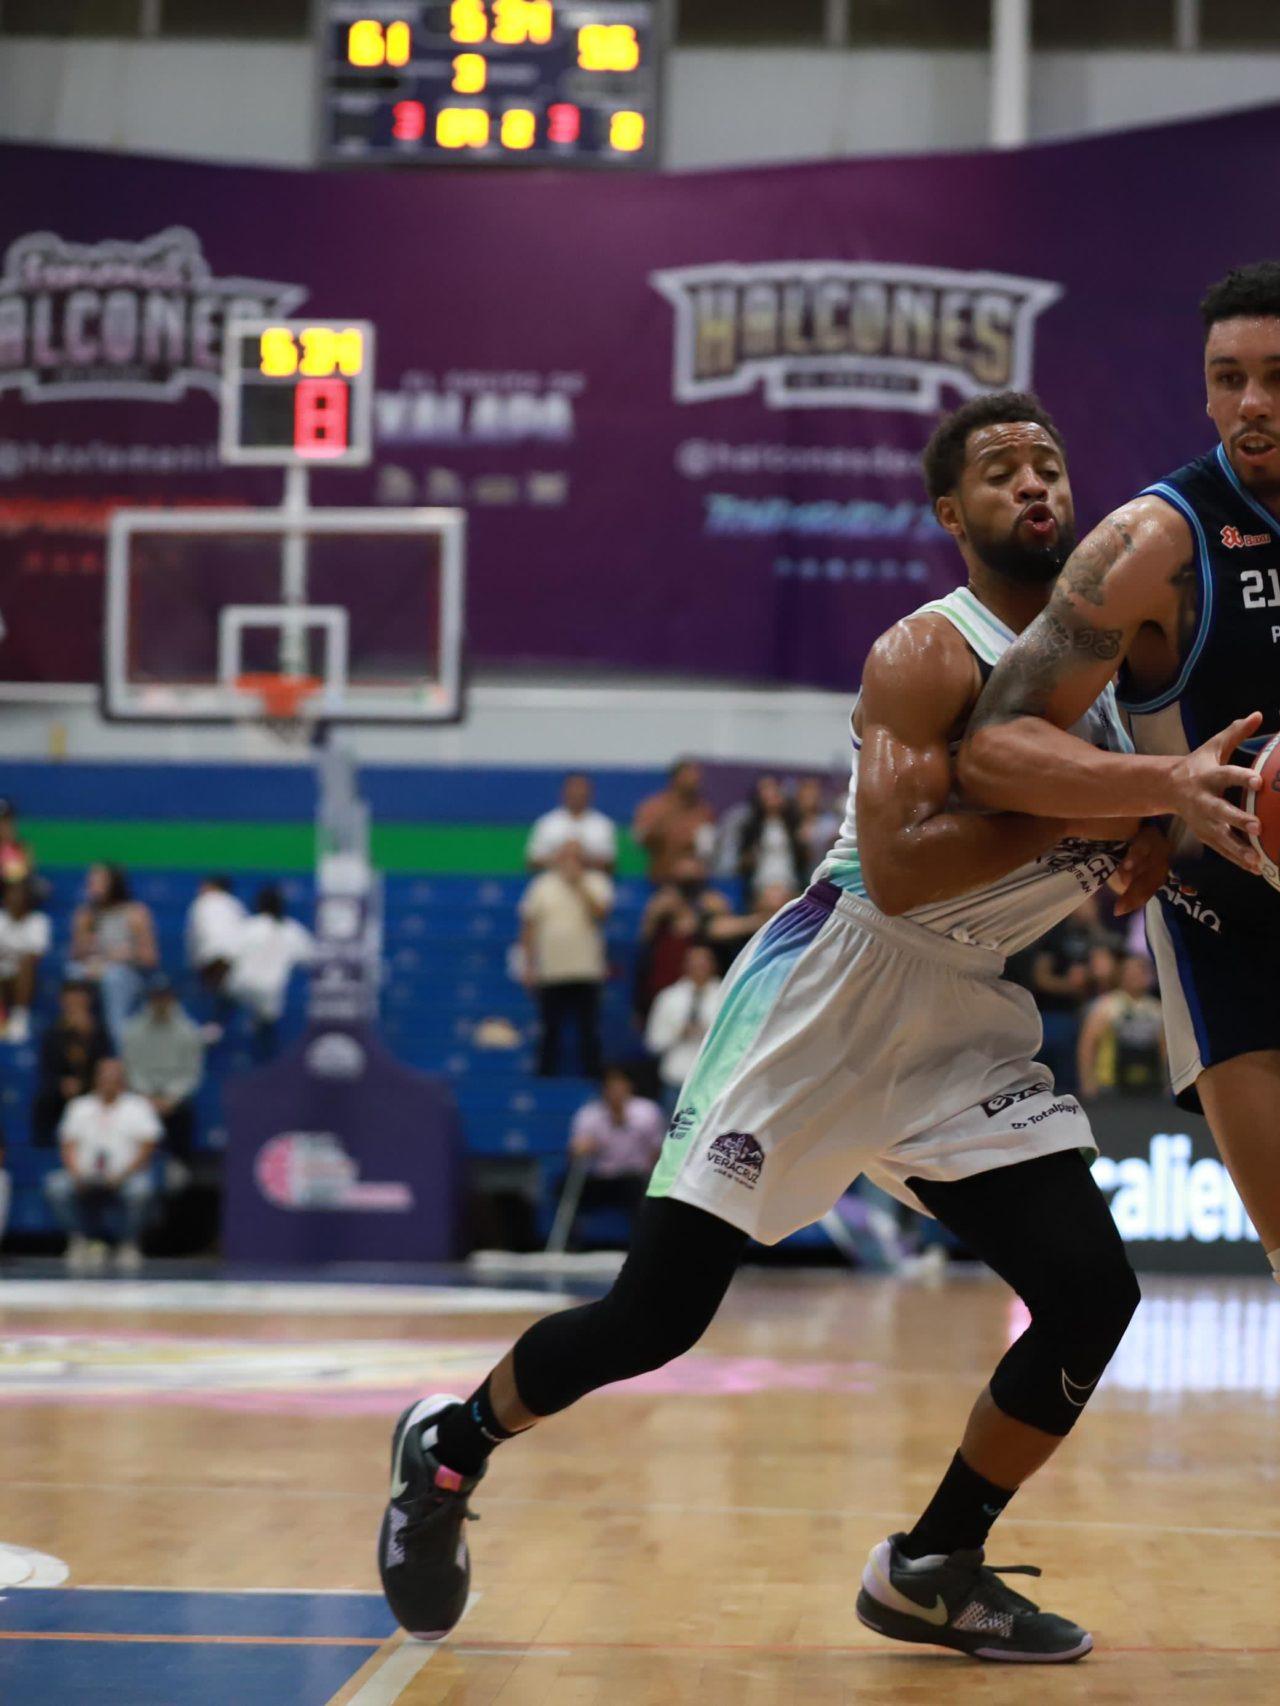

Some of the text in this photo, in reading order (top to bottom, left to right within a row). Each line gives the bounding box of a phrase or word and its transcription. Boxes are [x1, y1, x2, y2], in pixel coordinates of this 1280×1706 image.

[693, 281, 1016, 390] HALCONES
[295, 378, 348, 459] 8
[706, 1152, 760, 1184] VERACRUZ
